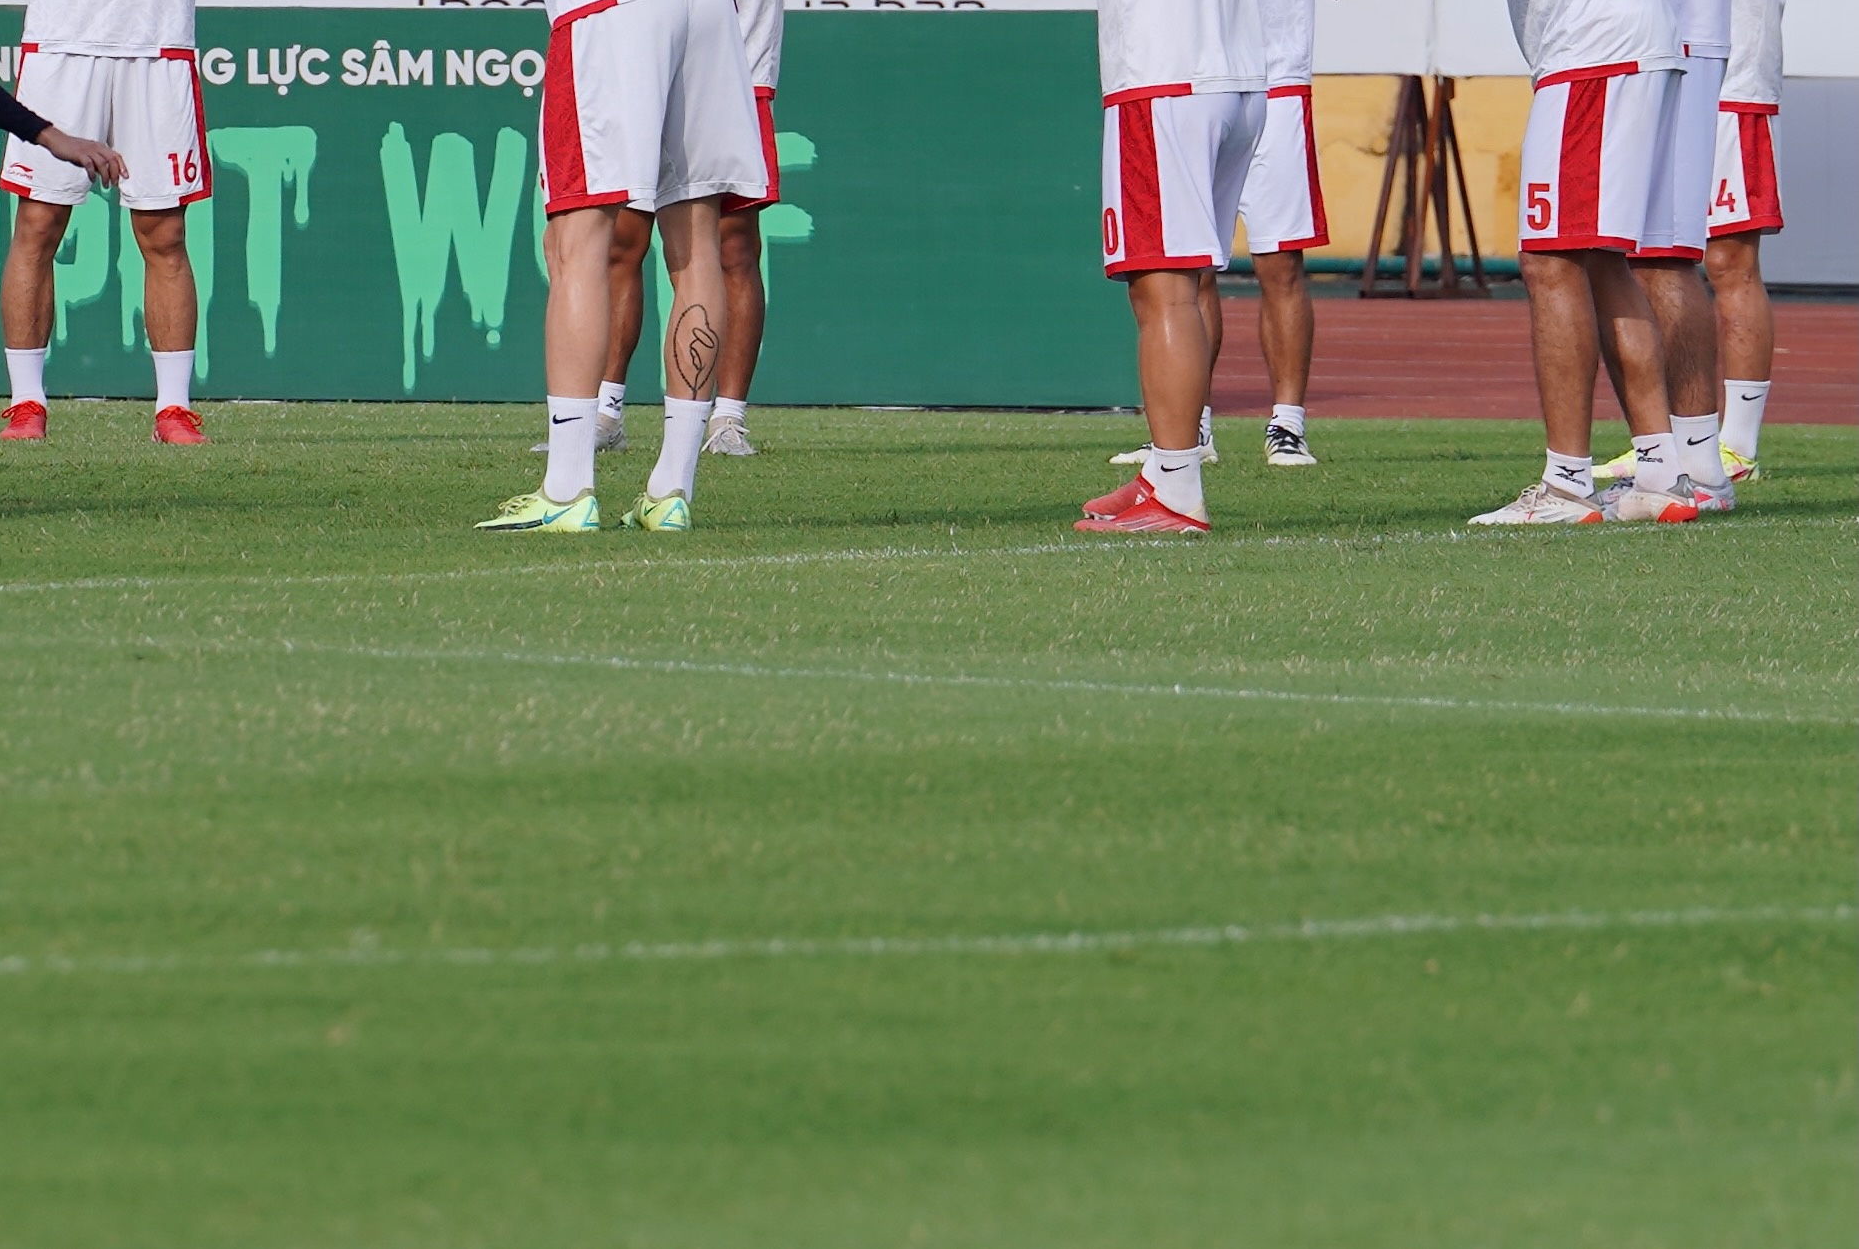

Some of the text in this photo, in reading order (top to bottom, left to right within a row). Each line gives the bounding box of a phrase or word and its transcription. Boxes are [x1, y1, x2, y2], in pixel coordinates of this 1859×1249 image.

[247, 44, 330, 96] LỰC
[341, 39, 433, 86] SÂM
[445, 48, 546, 98] NGỌ
[167, 149, 198, 187] 16
[1526, 182, 1552, 231] 5
[1707, 178, 1736, 216] 4
